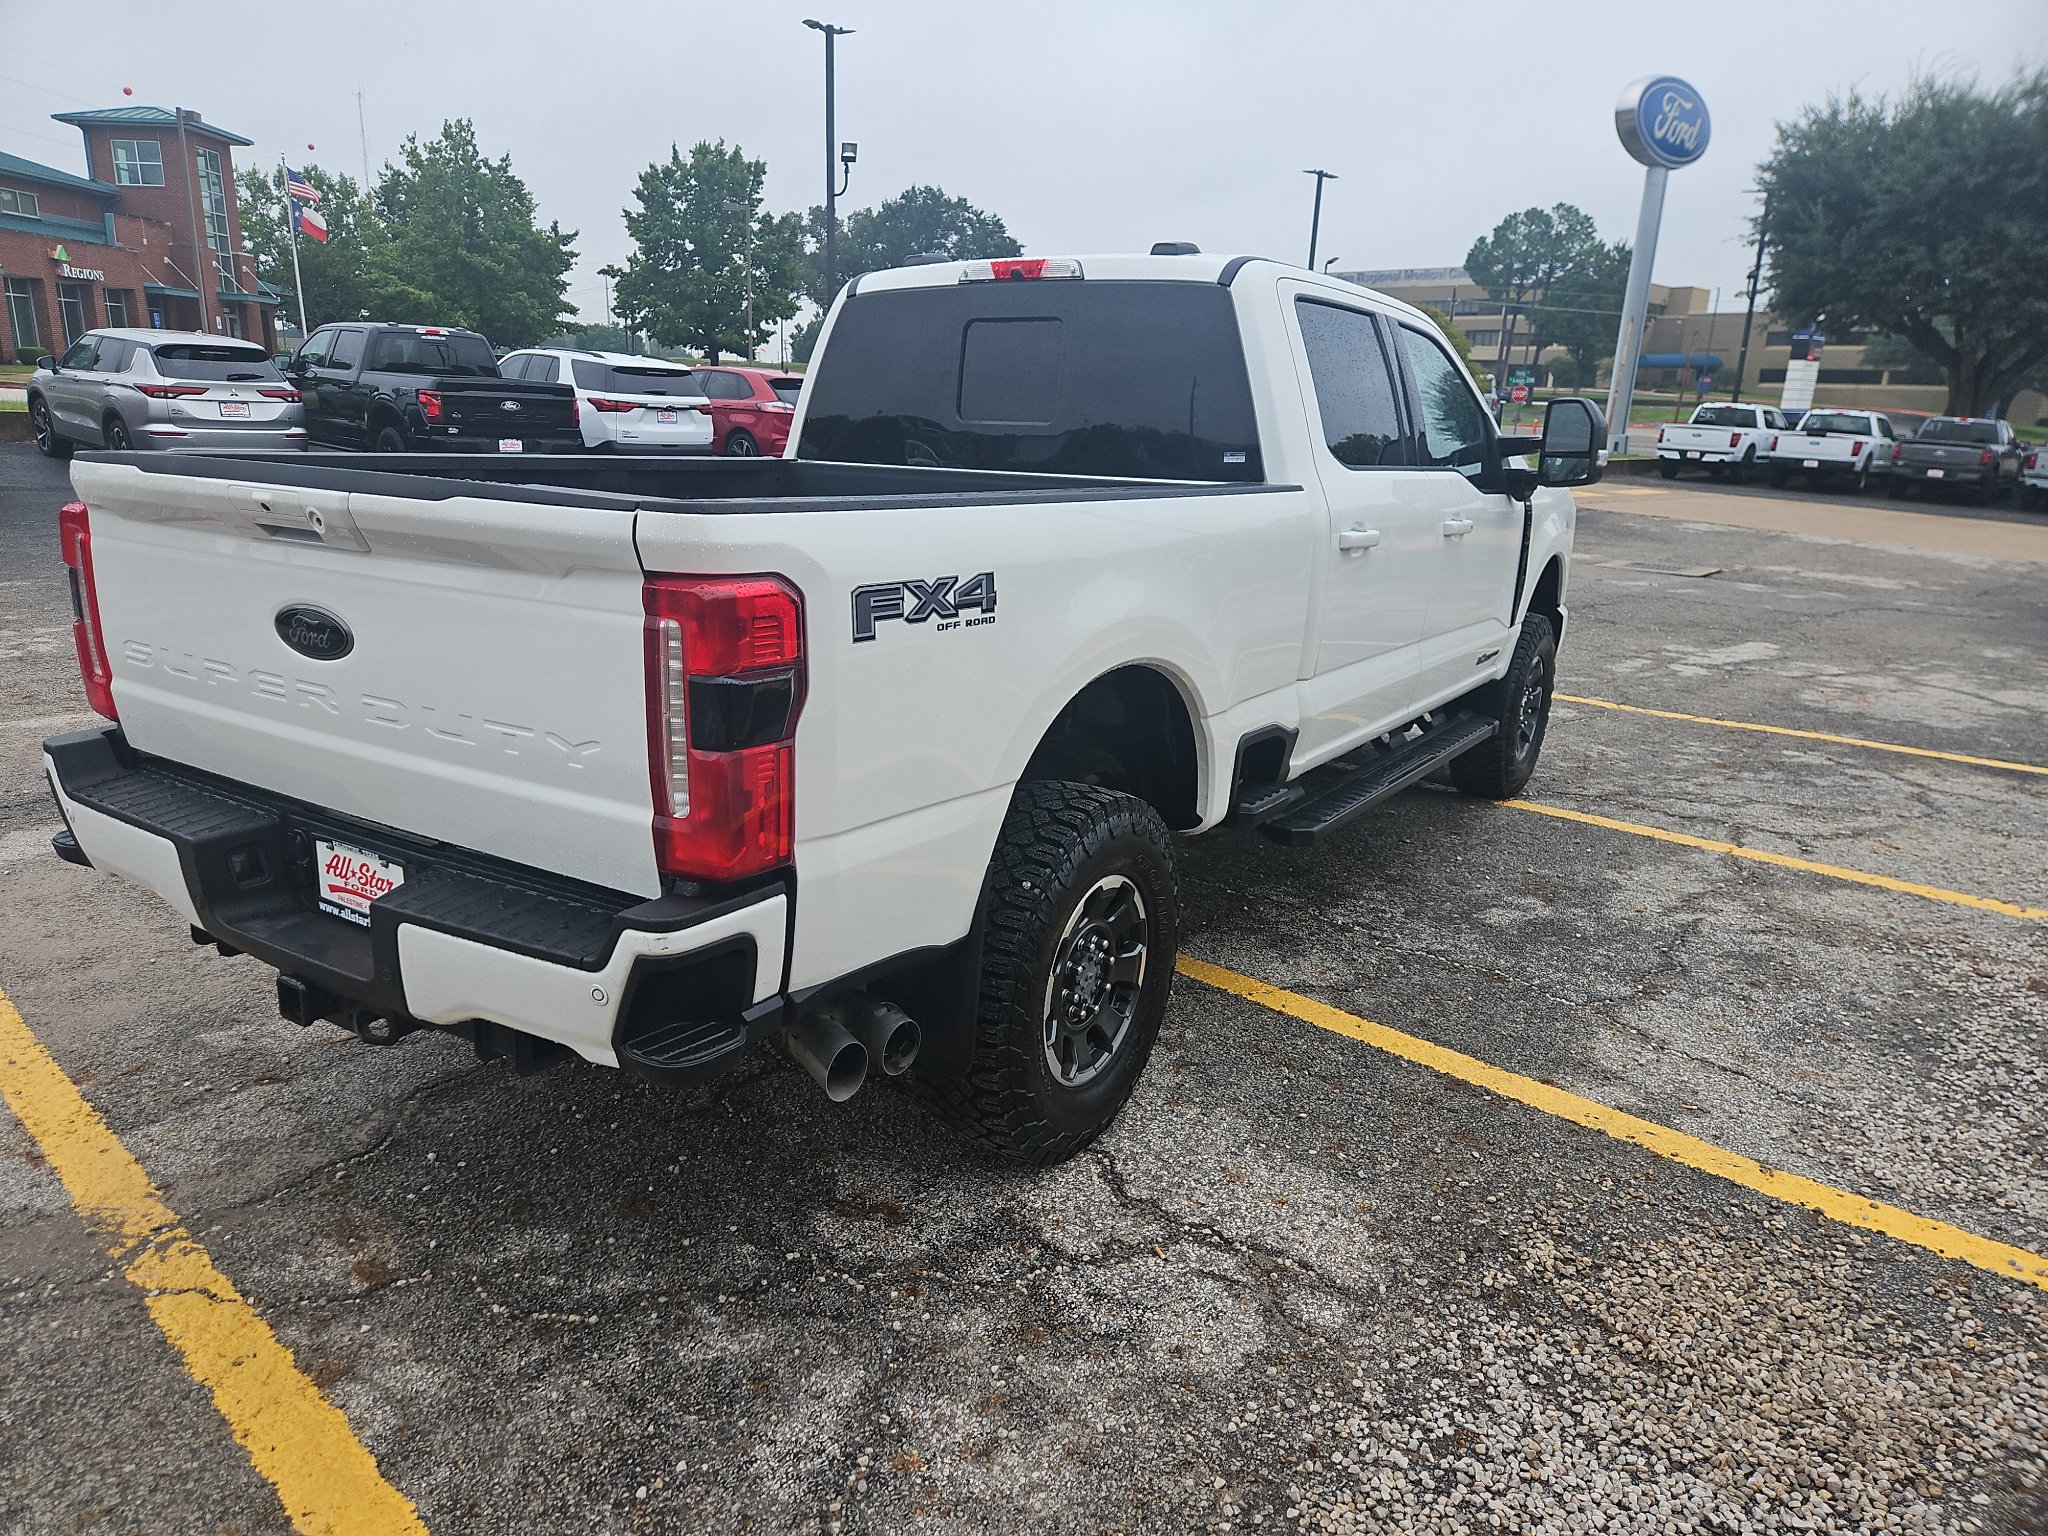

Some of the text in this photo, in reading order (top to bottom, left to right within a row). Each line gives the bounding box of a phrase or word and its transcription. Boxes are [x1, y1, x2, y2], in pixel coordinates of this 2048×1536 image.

[1654, 91, 1702, 150] Ford
[62, 263, 105, 281] REGIONS
[1512, 389, 1527, 398] STOP
[850, 571, 997, 644] FX4
[289, 613, 331, 649] Ford
[936, 616, 996, 632] OFF ROAD
[123, 639, 602, 768] SUPER DUTY
[344, 881, 378, 897] FORD
[337, 895, 364, 909] PALESTINE
